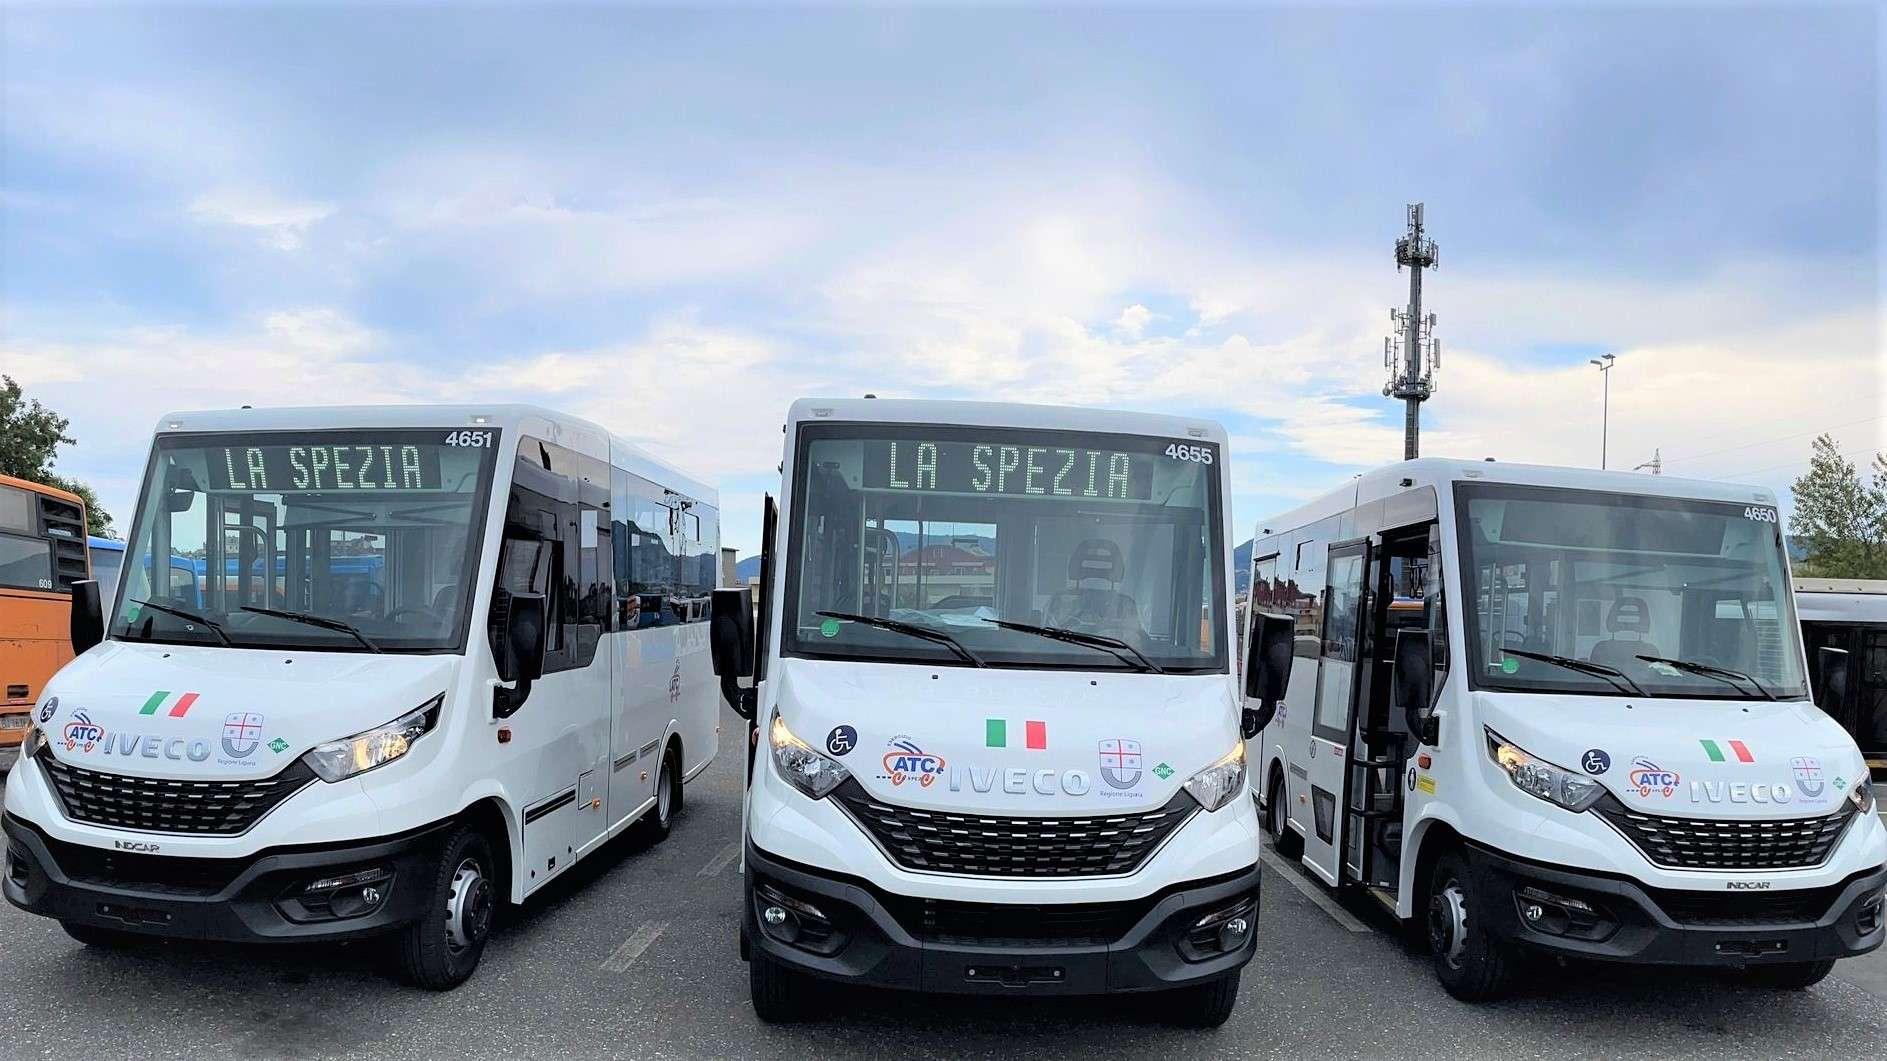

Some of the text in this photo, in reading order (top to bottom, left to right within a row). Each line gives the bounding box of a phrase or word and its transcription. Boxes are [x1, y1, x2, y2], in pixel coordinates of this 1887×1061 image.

[445, 431, 493, 448] 4651
[1164, 443, 1213, 465] 4655
[225, 446, 422, 489] LA SPEZIA
[890, 442, 1129, 498] LA SPEZIA
[1744, 507, 1777, 523] 4650
[39, 579, 52, 589] 609
[69, 726, 98, 741] ATC
[103, 730, 211, 762] IVECO
[893, 756, 936, 774] ATC
[1155, 766, 1172, 776] GNC
[949, 760, 1091, 797] IVECO
[1639, 773, 1673, 786] ATC
[1689, 780, 1793, 804] IVECO
[114, 840, 160, 853] INDCAR
[1726, 881, 1771, 889] INDCAR
